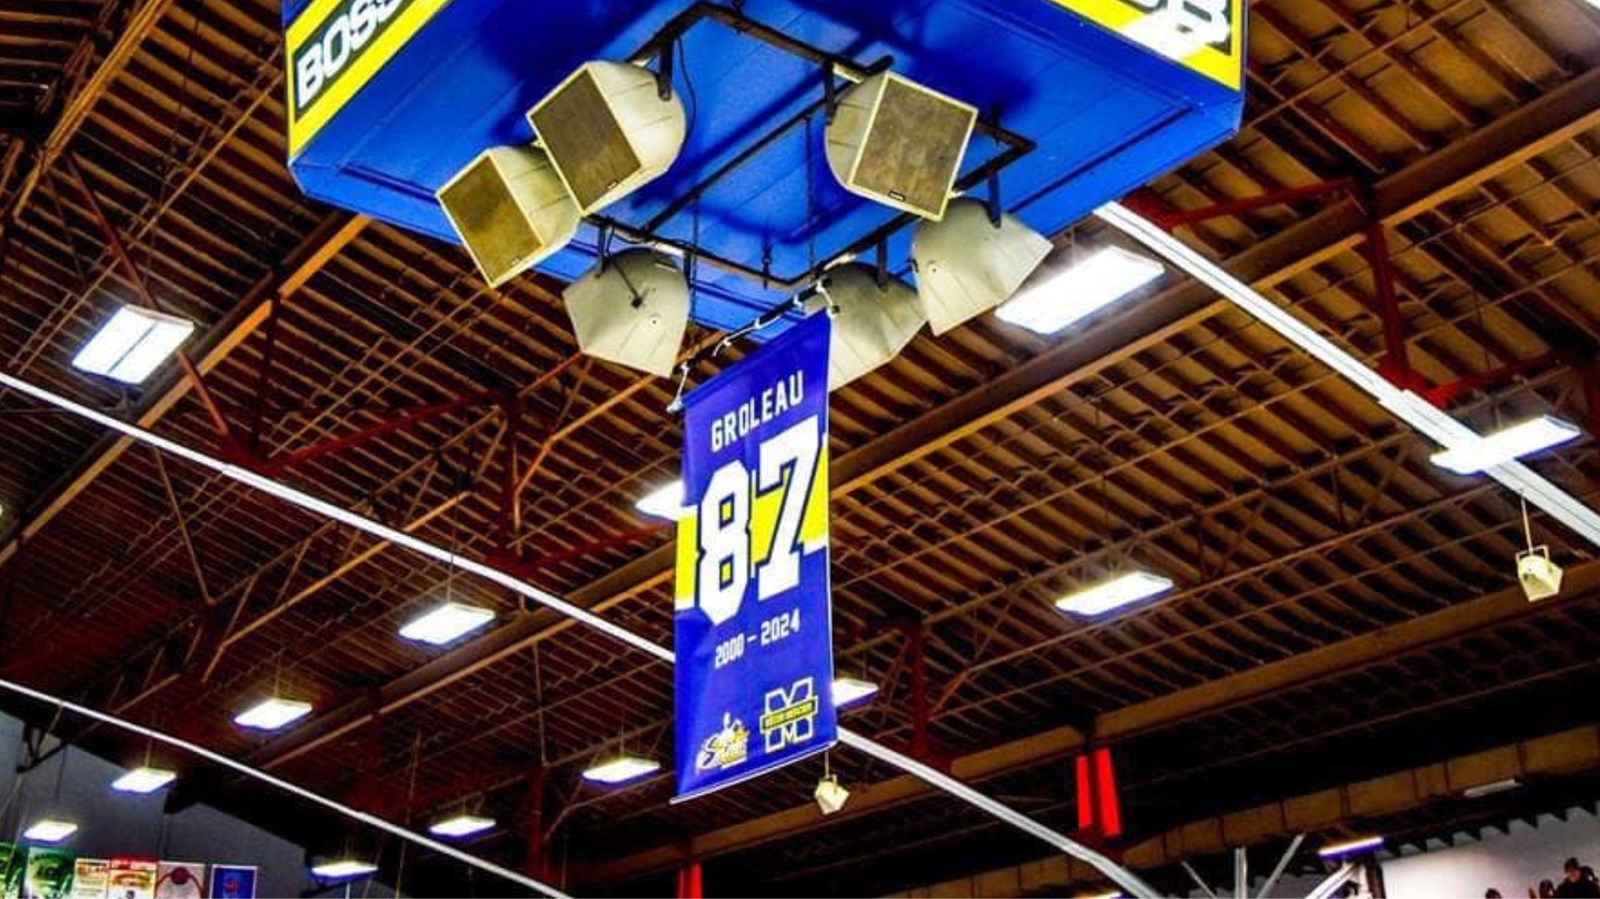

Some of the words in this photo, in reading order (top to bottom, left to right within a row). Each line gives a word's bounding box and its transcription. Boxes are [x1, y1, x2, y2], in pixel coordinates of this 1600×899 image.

[297, 0, 402, 109] BOS
[711, 370, 803, 453] GROLEAU
[699, 414, 818, 626] 87
[715, 633, 744, 668] 2000
[761, 607, 799, 646] 2024
